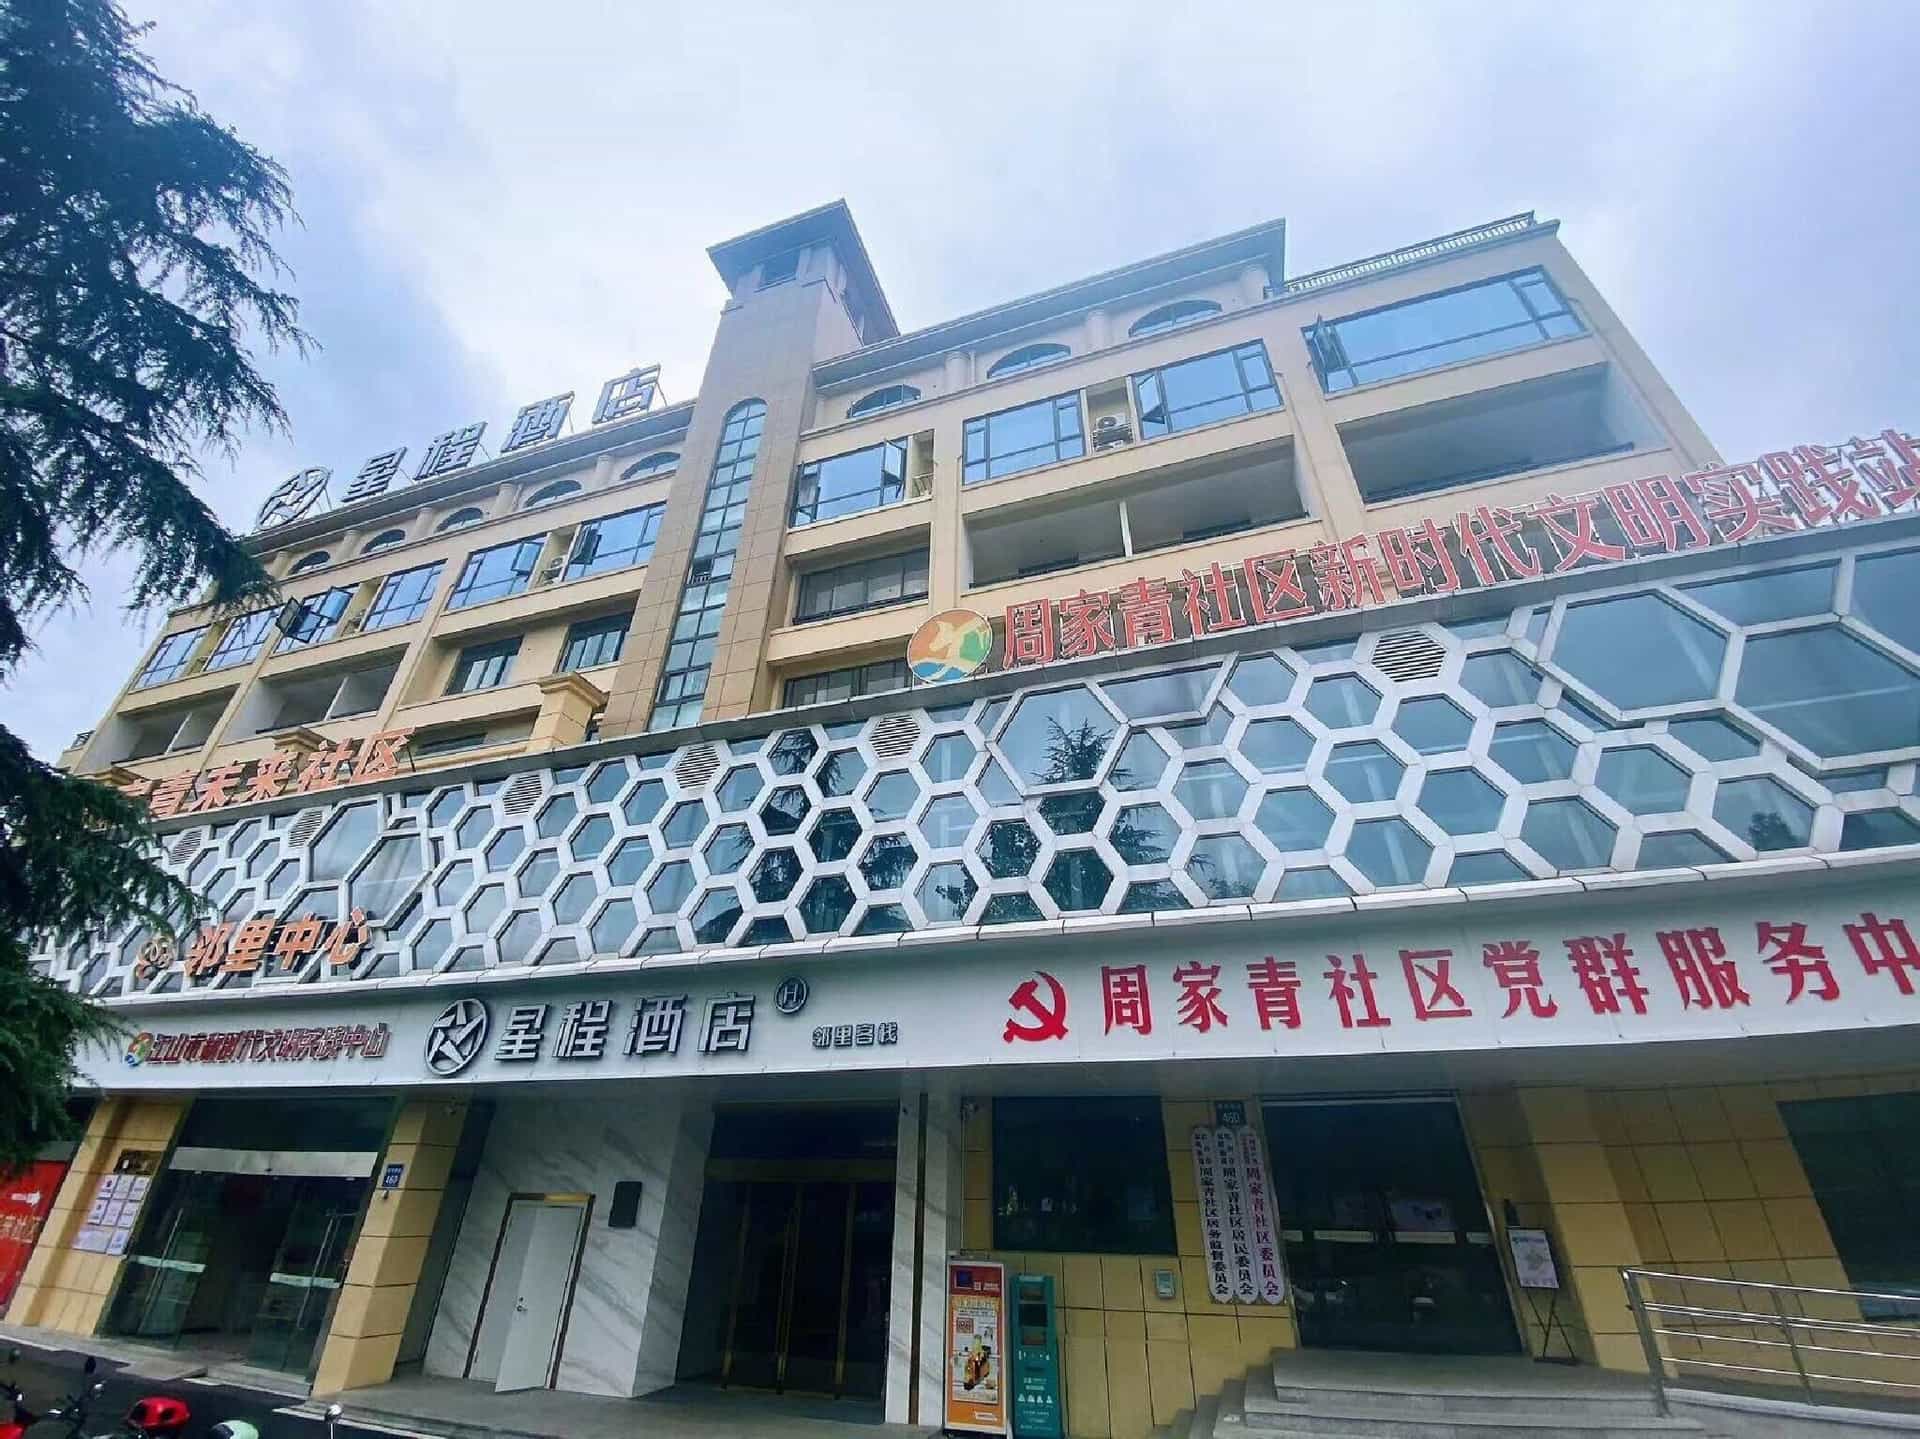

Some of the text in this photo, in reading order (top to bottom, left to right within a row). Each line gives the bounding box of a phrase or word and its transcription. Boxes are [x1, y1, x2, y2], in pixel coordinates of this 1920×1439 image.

[342, 364, 661, 502] 星程酒店
[184, 906, 370, 976] 邻里中心
[1100, 912, 1920, 1036] 周家青社区党群服务中
[494, 992, 756, 1061] 星程酒店
[812, 1021, 897, 1048] 邻里客栈
